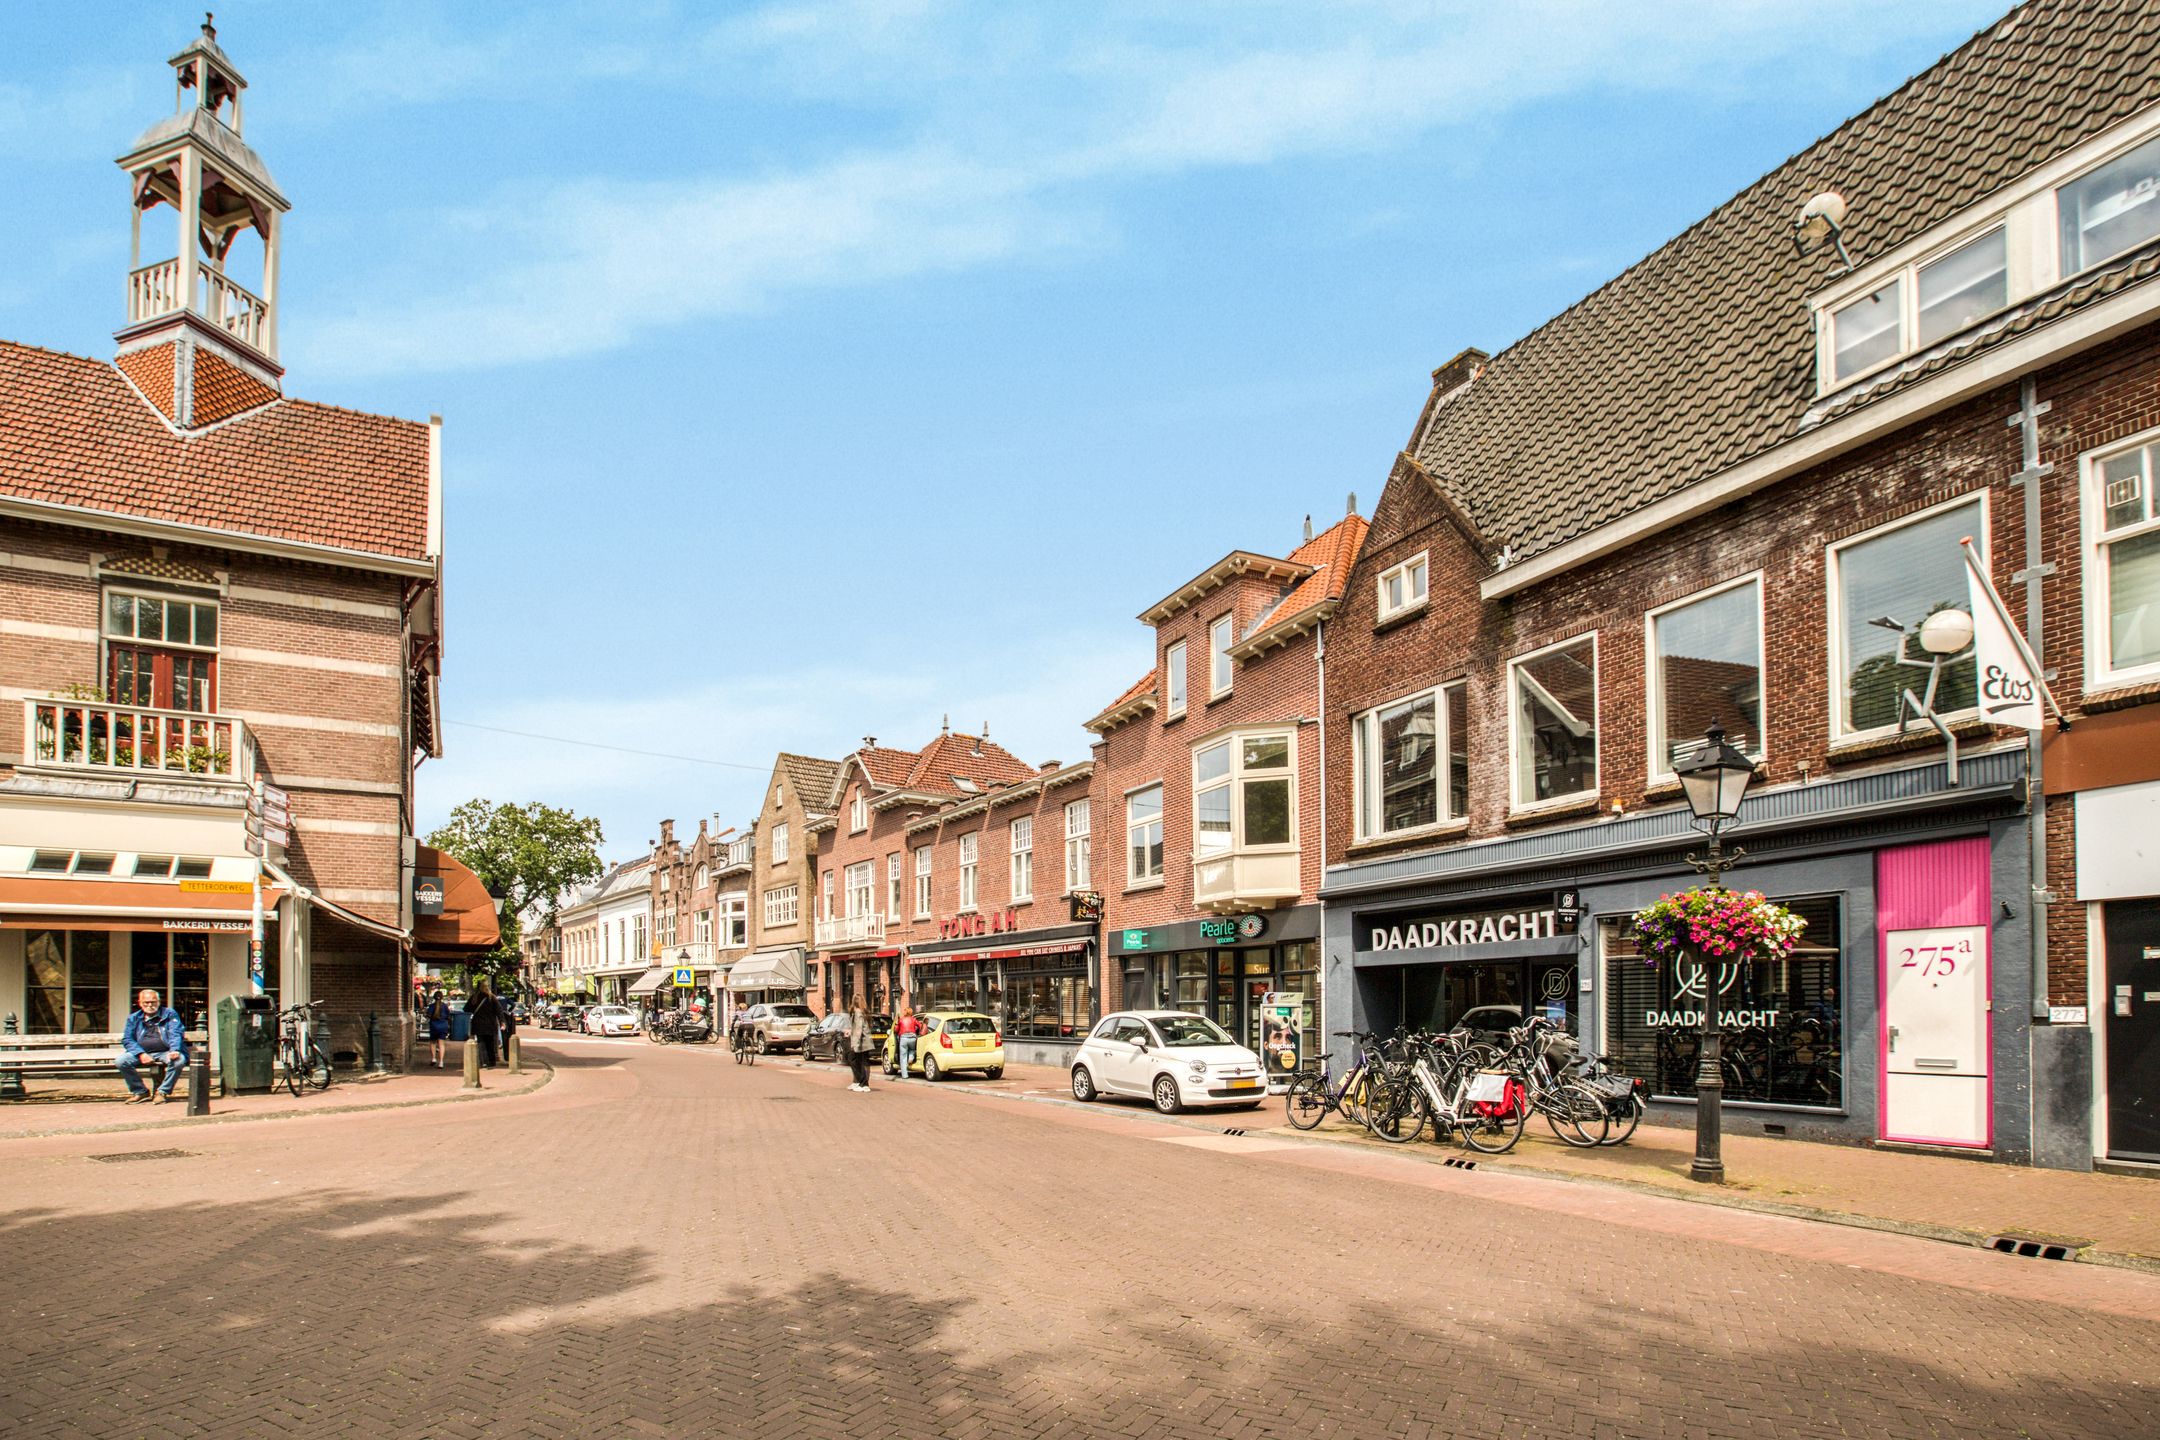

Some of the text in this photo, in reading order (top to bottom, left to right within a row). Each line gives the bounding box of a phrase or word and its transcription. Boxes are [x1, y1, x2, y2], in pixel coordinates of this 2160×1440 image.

[1983, 664, 2034, 702] Etos
[187, 882, 245, 892] TETTERODEWEG
[162, 920, 253, 931] BAKKERIJ VESSEM
[939, 914, 986, 939] TONG
[1199, 918, 1235, 939] Pearle
[1371, 910, 1556, 952] DAADKRACHT
